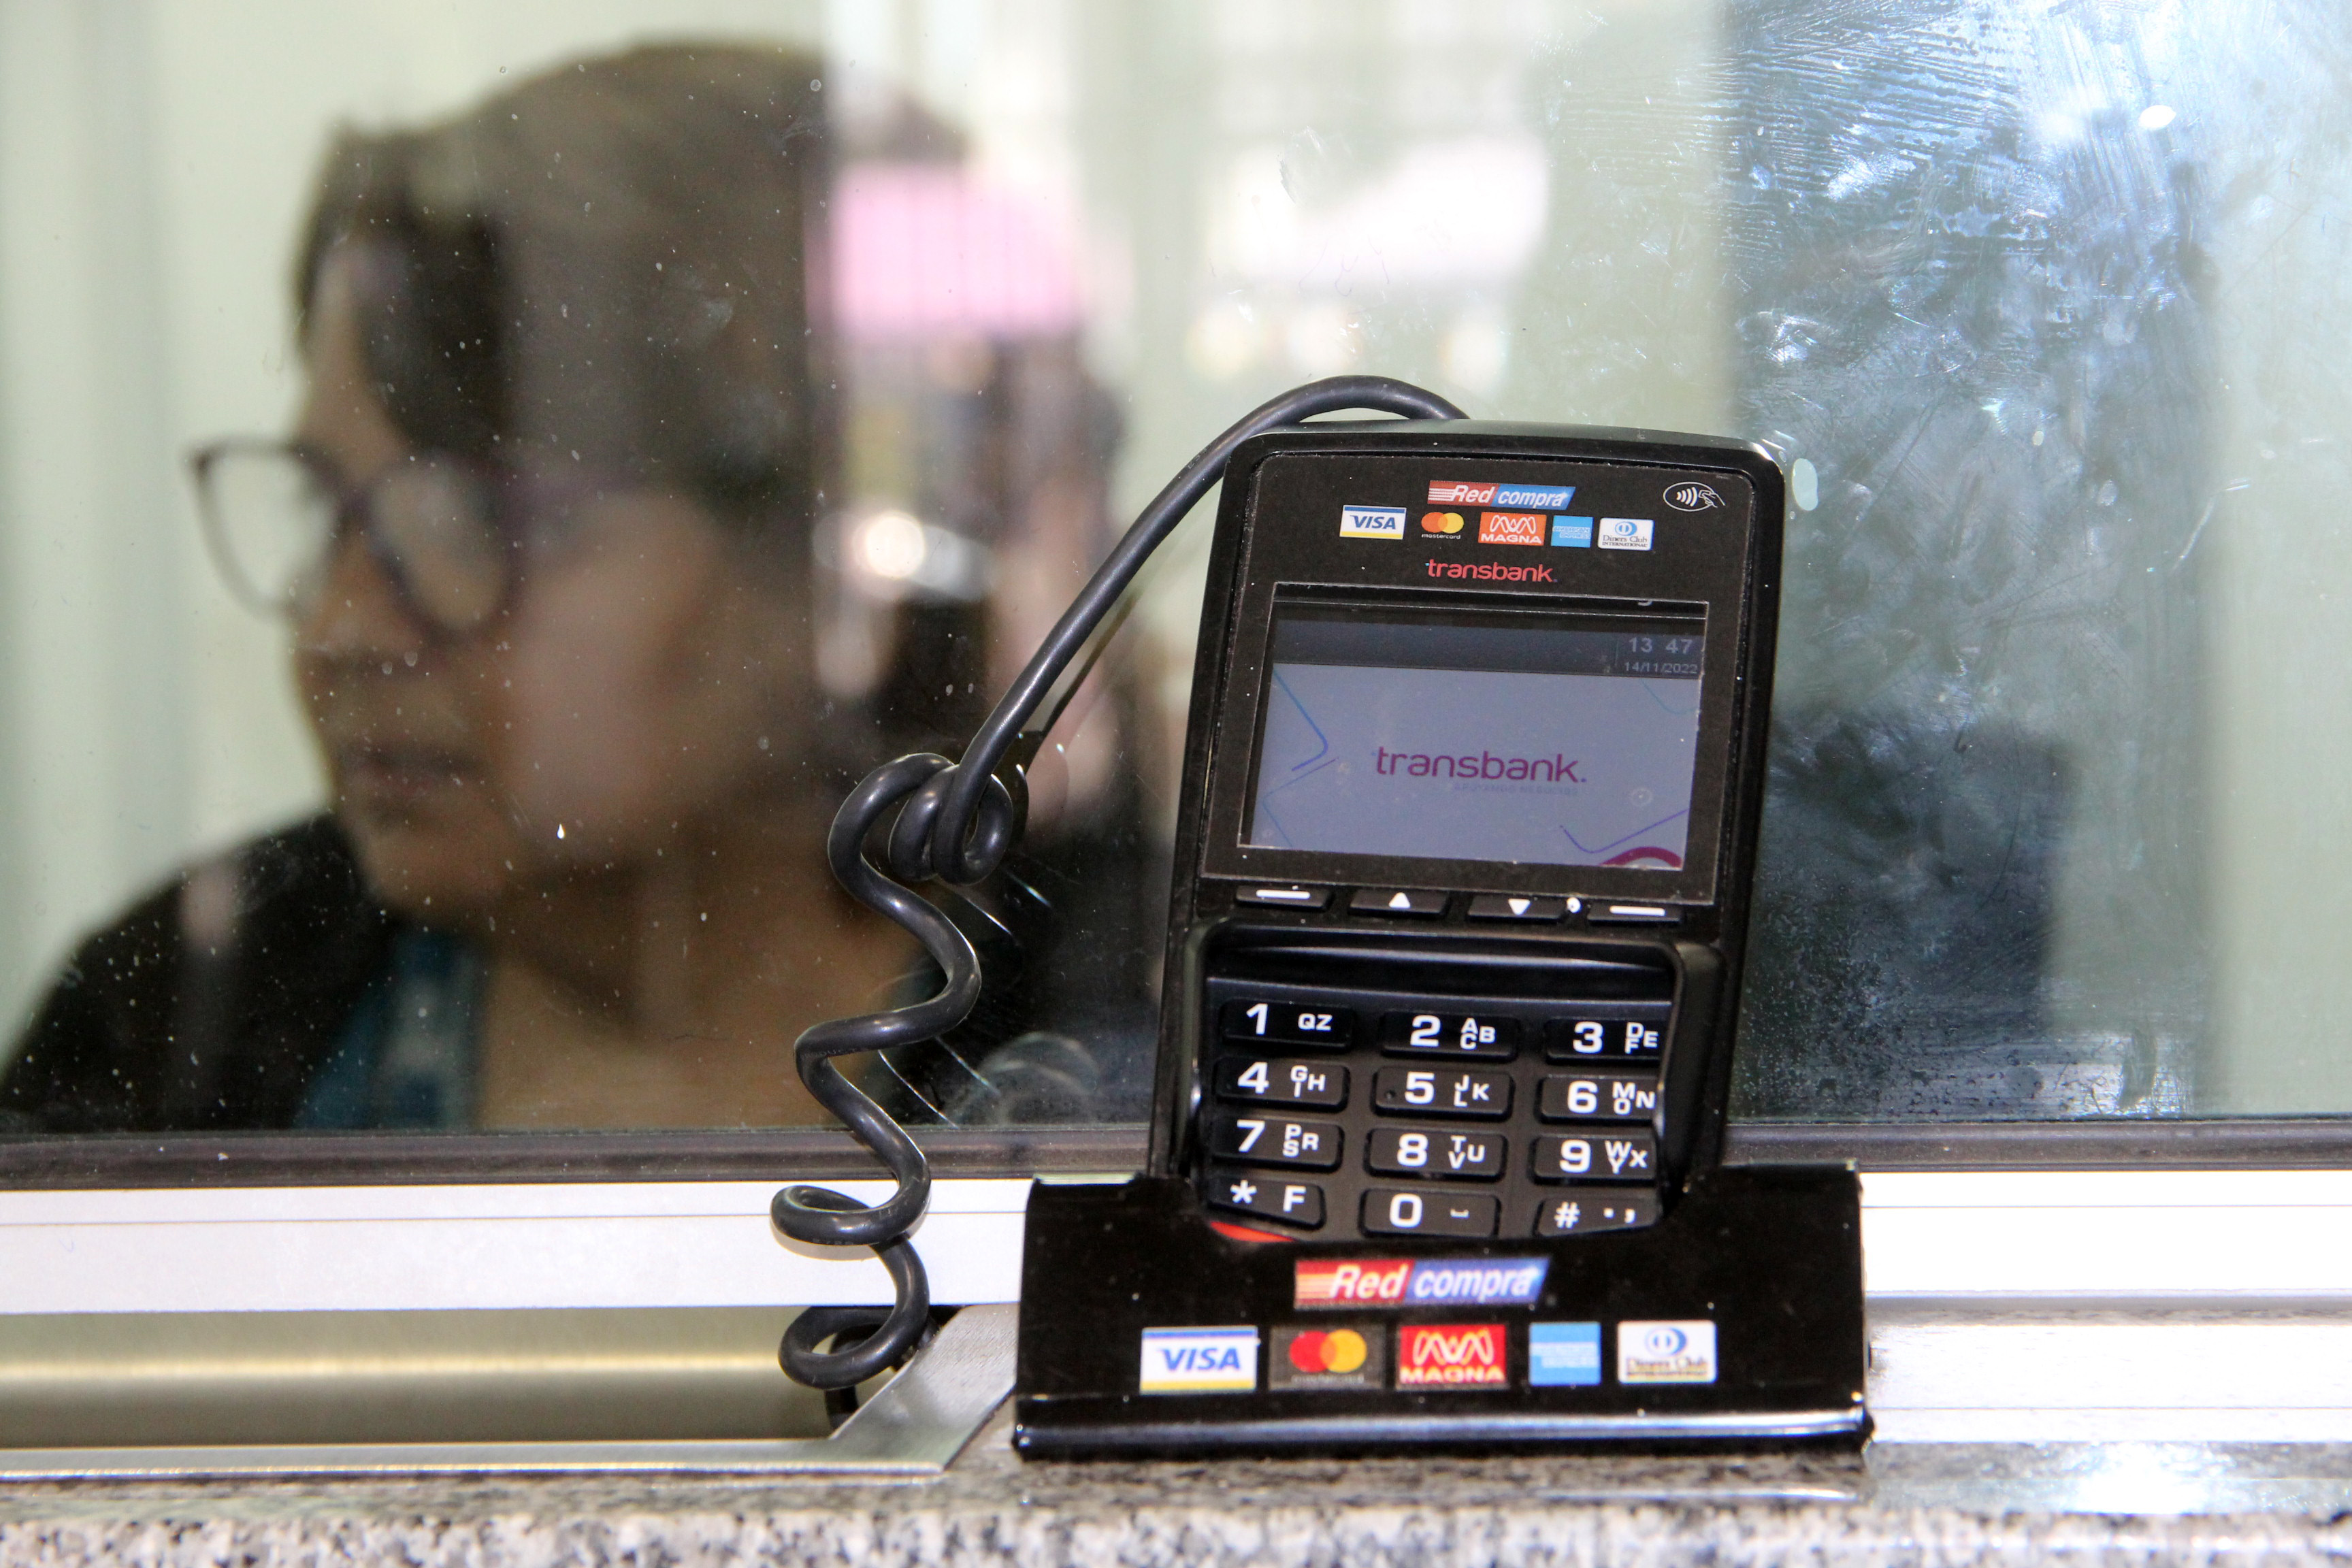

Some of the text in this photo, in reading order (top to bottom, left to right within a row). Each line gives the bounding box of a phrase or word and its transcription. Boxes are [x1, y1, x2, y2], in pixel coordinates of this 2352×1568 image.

[1450, 485, 1567, 509] Red compra
[1350, 514, 1396, 530] VISA
[1480, 533, 1541, 544] MAGNA
[1246, 1003, 1333, 1034] 1 QZ
[1410, 1015, 1441, 1047] 2
[1573, 1022, 1603, 1053] 3
[1237, 1062, 1269, 1094] 4
[1405, 1072, 1435, 1104] 5
[1567, 1080, 1597, 1113] 6
[1237, 1120, 1266, 1152] 7
[1396, 1133, 1428, 1166] 8
[1559, 1139, 1591, 1173] 9
[1282, 1186, 1307, 1212] F
[1554, 1202, 1580, 1228] #
[1328, 1264, 1533, 1303] Red compra
[1158, 1348, 1241, 1371] VISA
[1400, 1365, 1505, 1384] MAGNA
